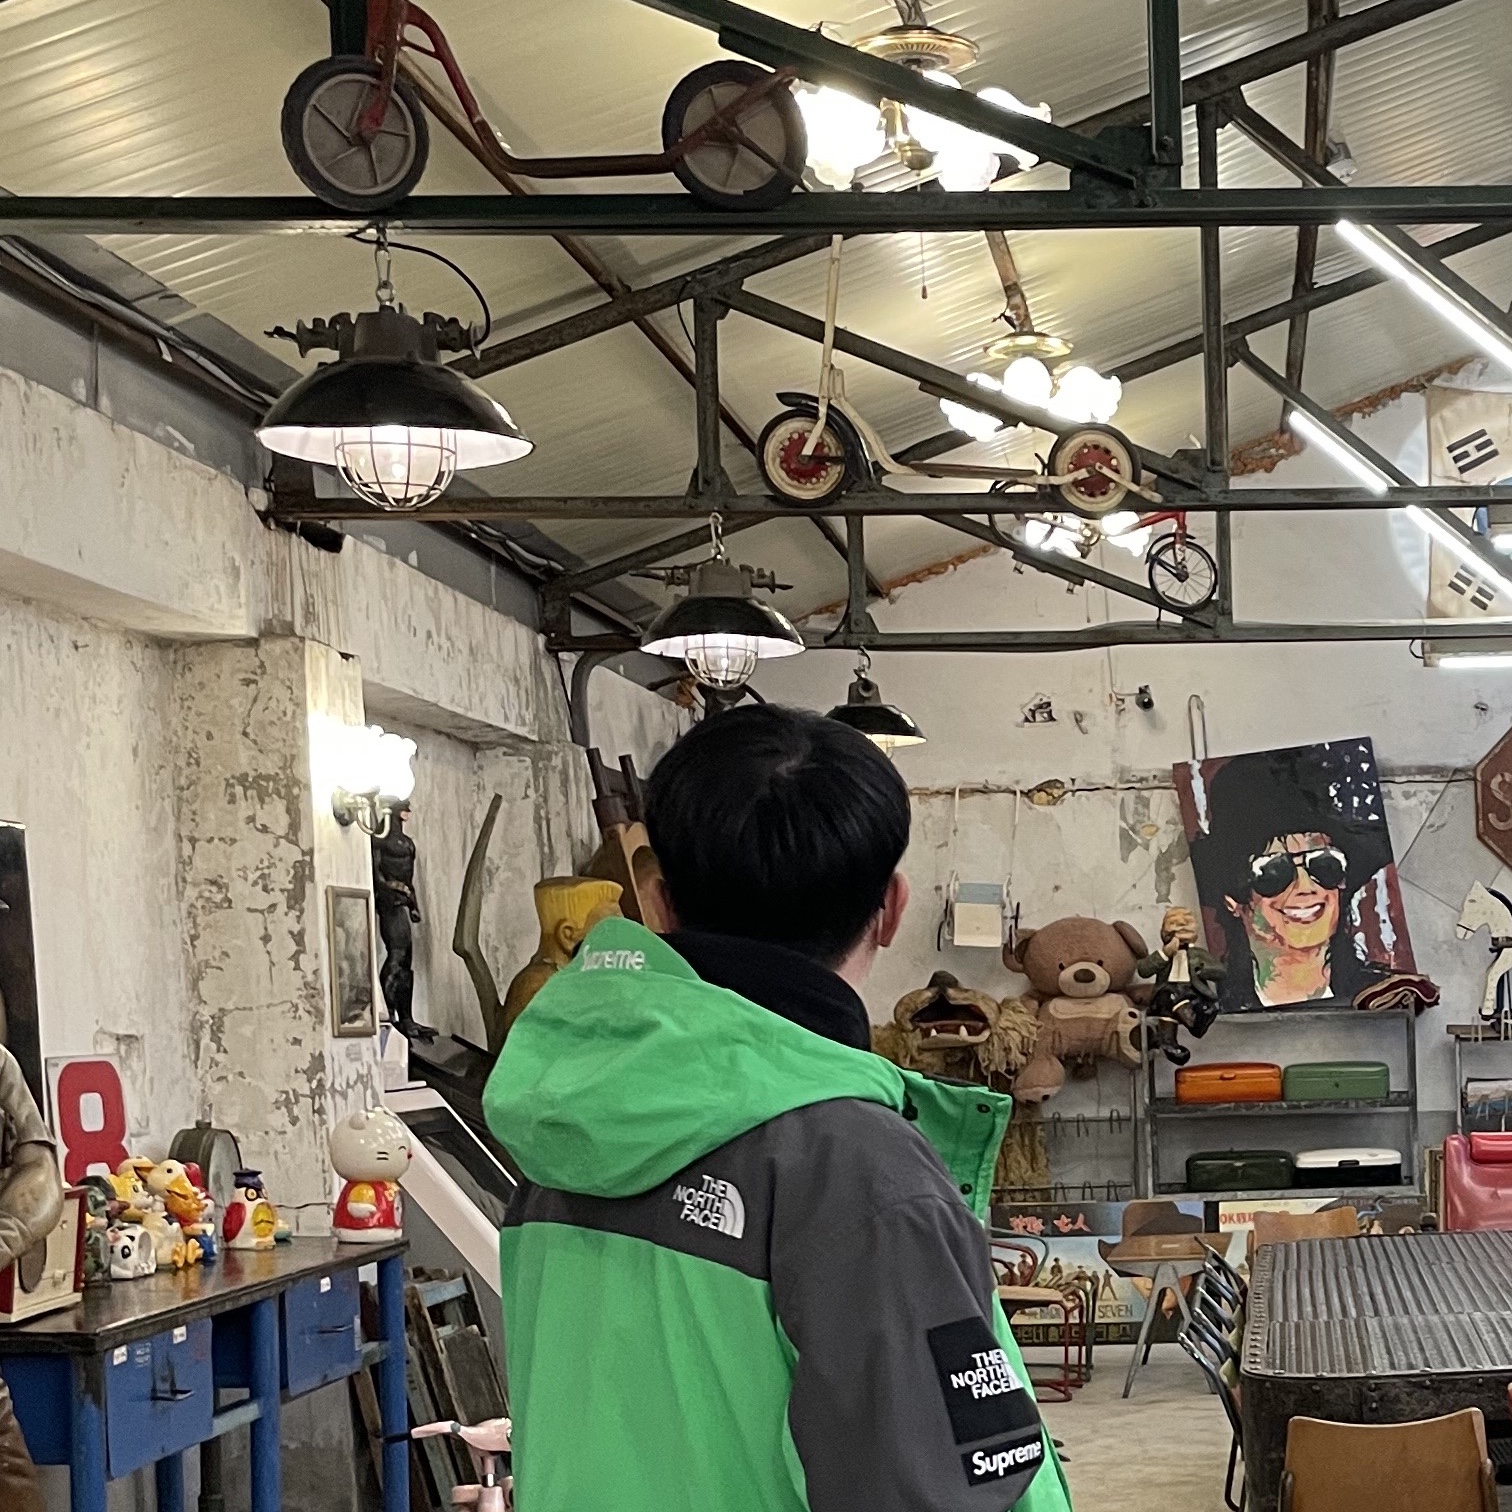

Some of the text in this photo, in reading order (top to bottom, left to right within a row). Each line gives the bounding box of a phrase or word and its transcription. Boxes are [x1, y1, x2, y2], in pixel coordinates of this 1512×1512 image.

[702, 1174, 728, 1197] THE
[672, 1184, 725, 1215] NORTH
[680, 1204, 722, 1230] FACE
[1097, 1303, 1133, 1319] SEVEN
[971, 1349, 1004, 1369] THE
[950, 1364, 1007, 1388] NORTH
[971, 1378, 1011, 1399] FACE
[972, 1441, 1042, 1476] Supreme
